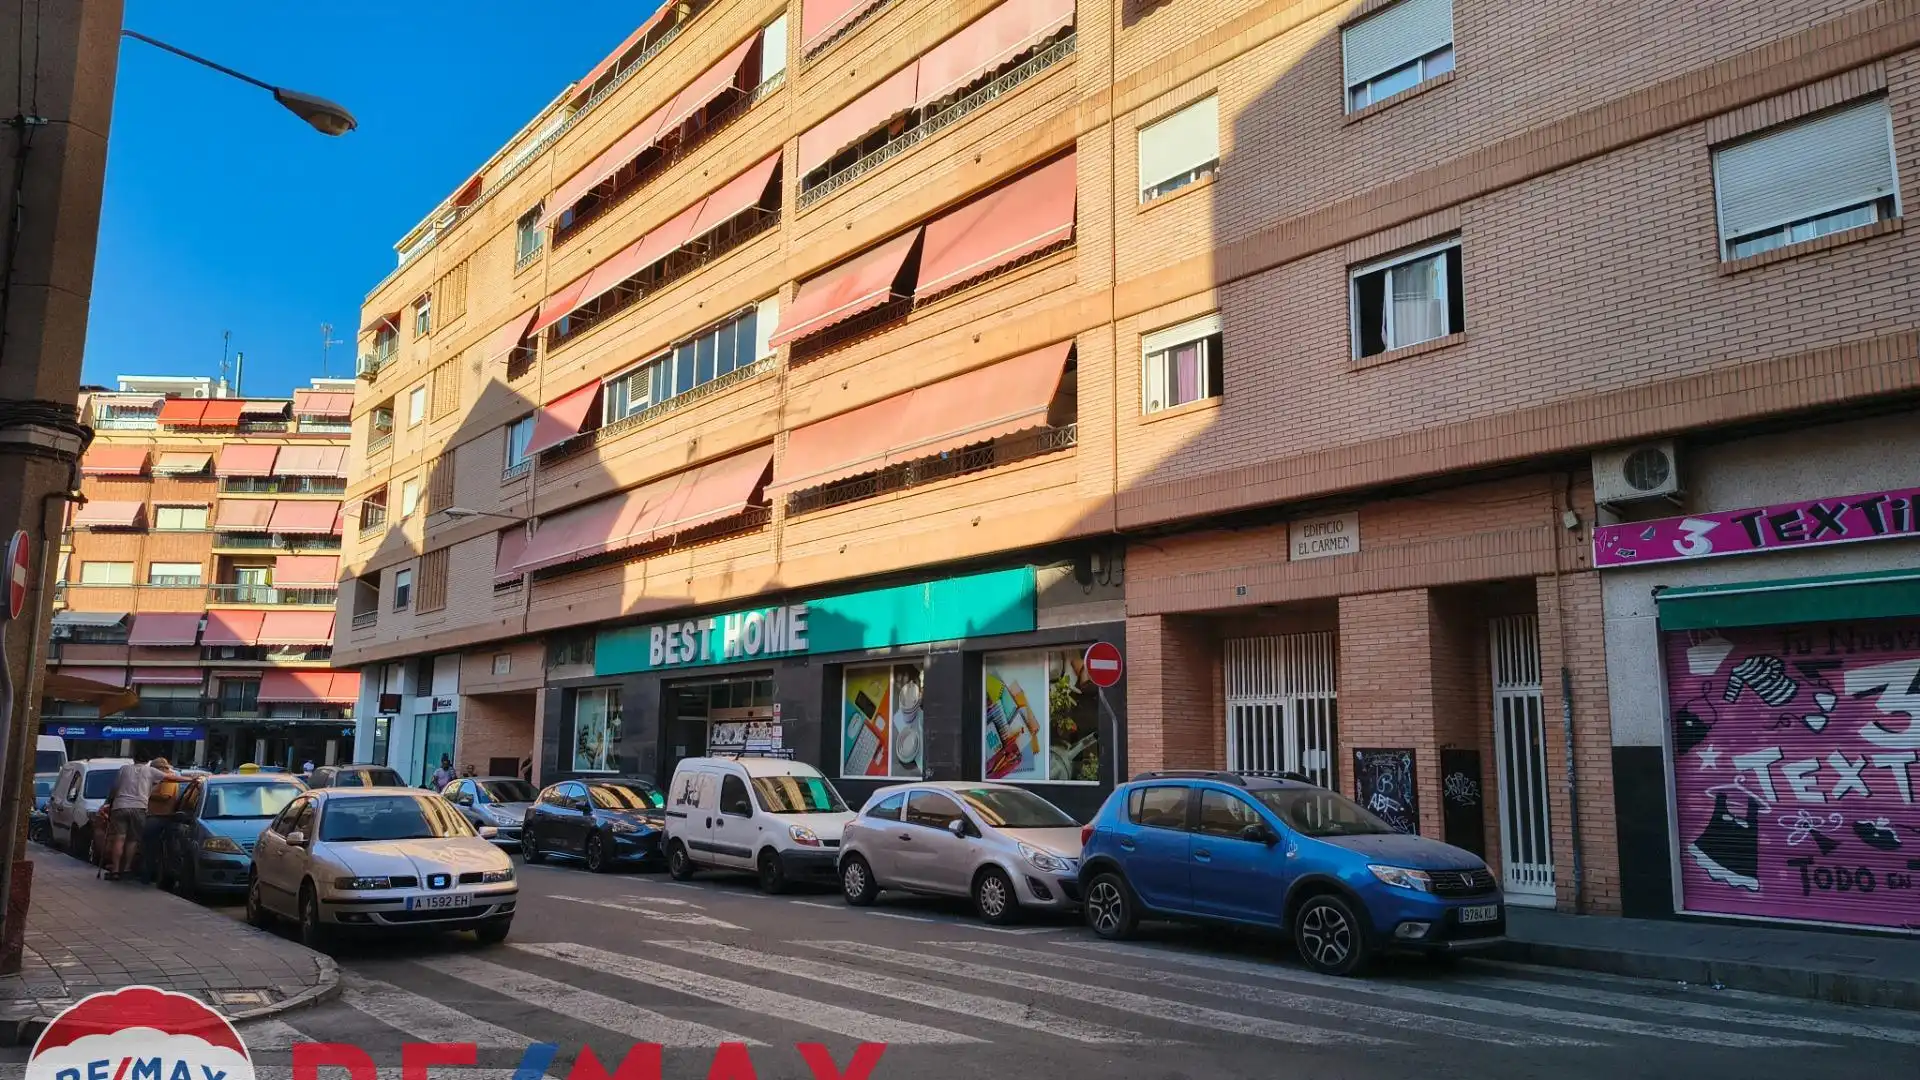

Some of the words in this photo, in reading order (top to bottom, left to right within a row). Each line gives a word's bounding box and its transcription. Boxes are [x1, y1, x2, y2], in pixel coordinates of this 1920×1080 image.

[1298, 541, 1310, 555] EL
[1311, 535, 1350, 552] CARMEN
[1303, 519, 1344, 538] EDIFICIO
[1673, 518, 1721, 555] 3
[650, 618, 716, 666] BEST
[723, 604, 810, 658] HOME
[1844, 658, 1920, 750] 3
[1731, 746, 1920, 806] TEXT
[415, 900, 422, 909] A
[426, 897, 452, 908] 1592
[454, 895, 468, 906] EH
